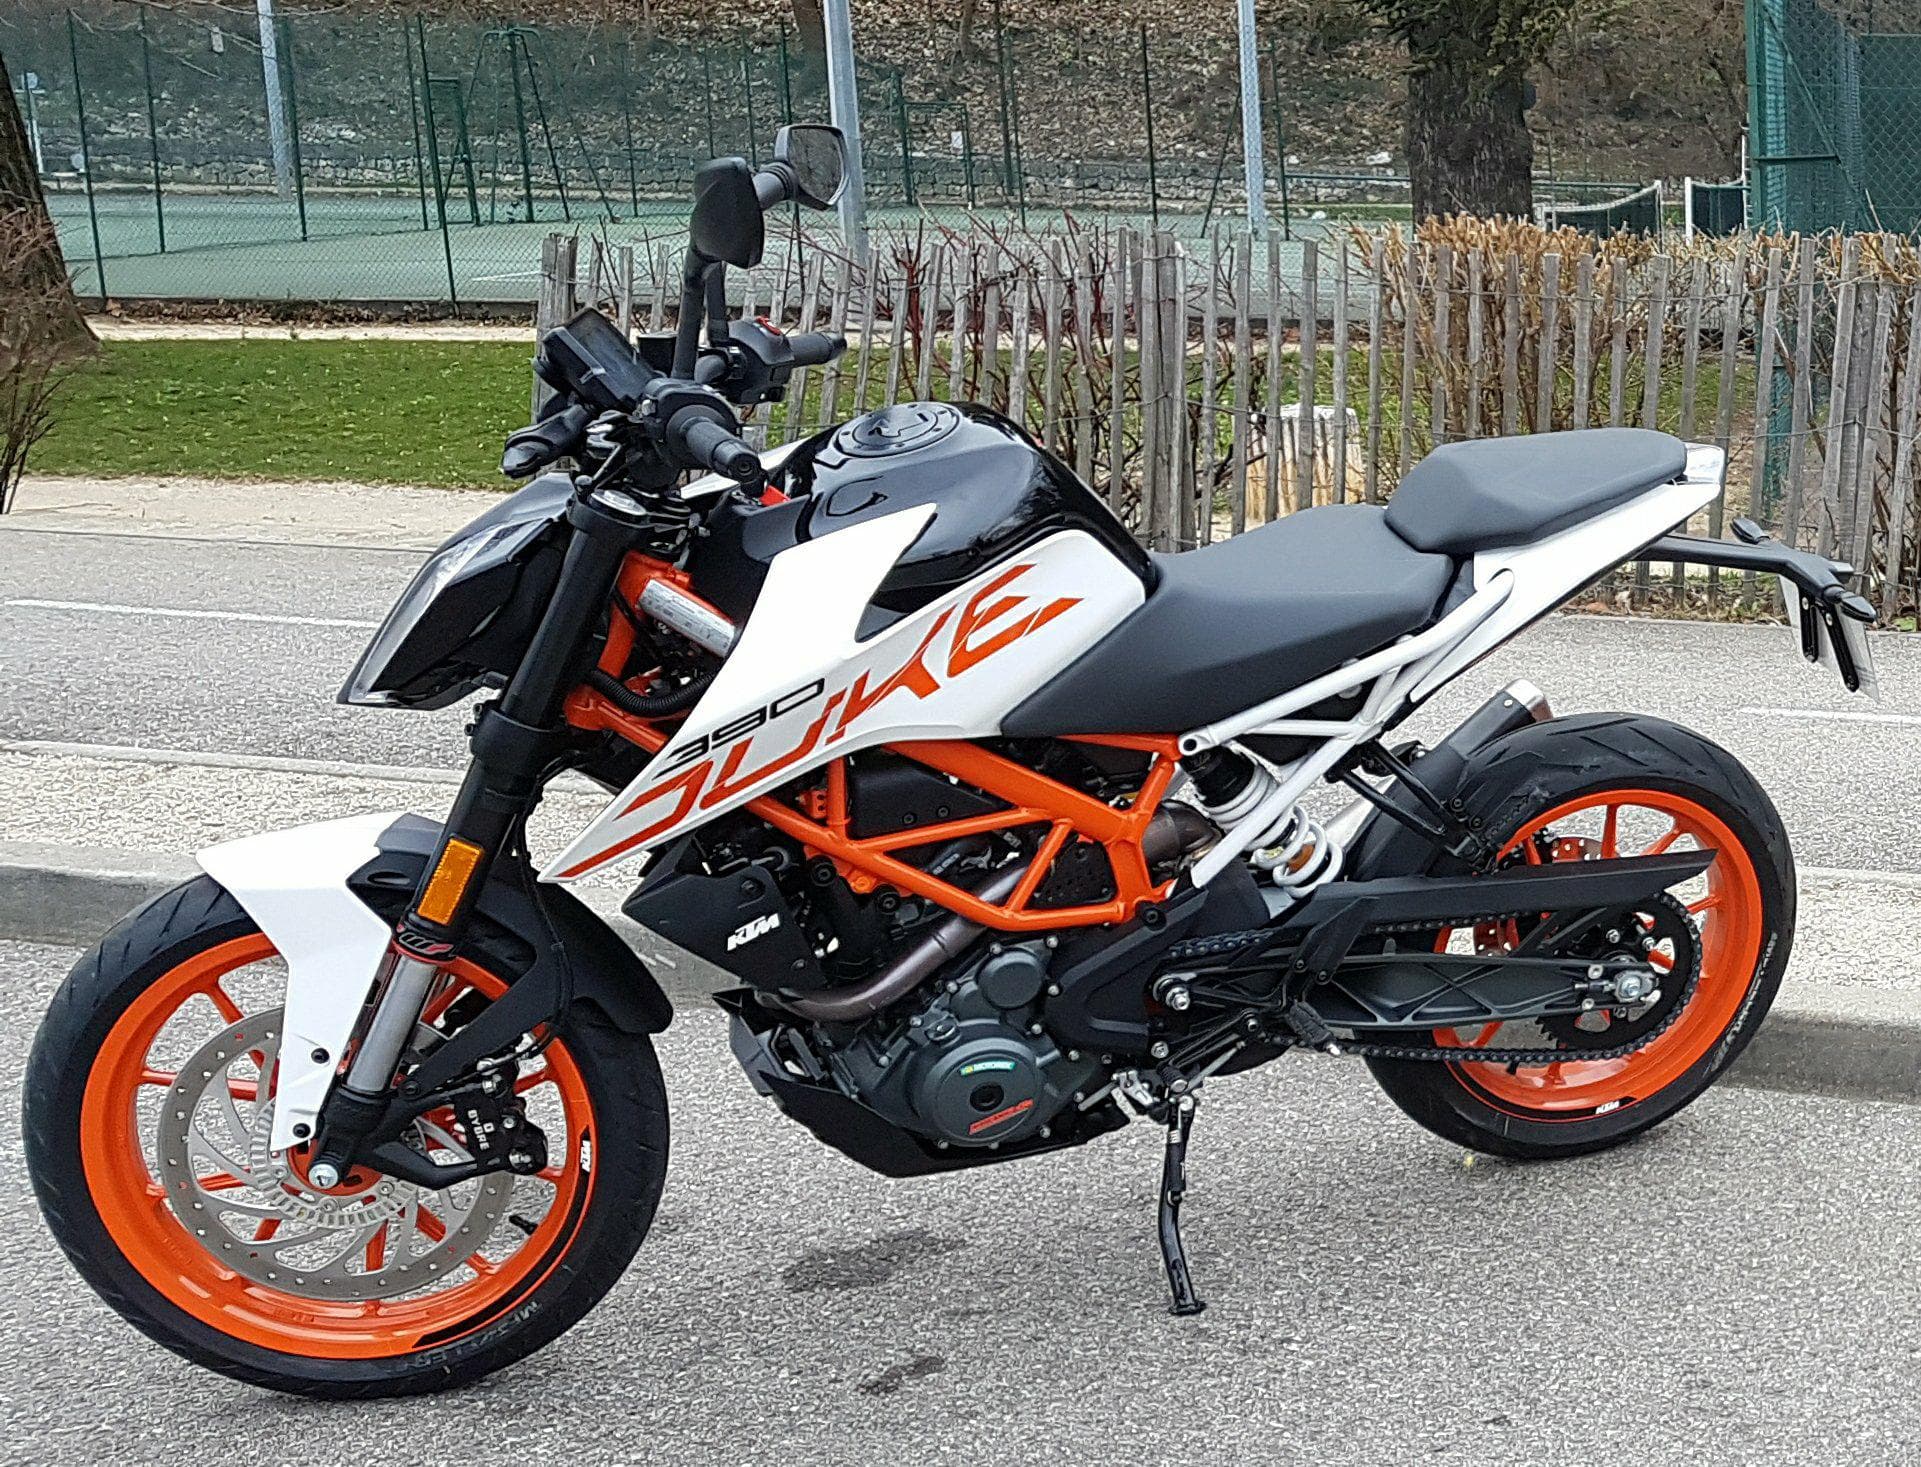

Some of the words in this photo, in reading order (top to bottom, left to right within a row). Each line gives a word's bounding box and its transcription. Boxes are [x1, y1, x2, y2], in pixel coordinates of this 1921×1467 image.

[555, 564, 1084, 877] DUKE
[651, 678, 825, 781] 390
[727, 913, 780, 951] KTM
